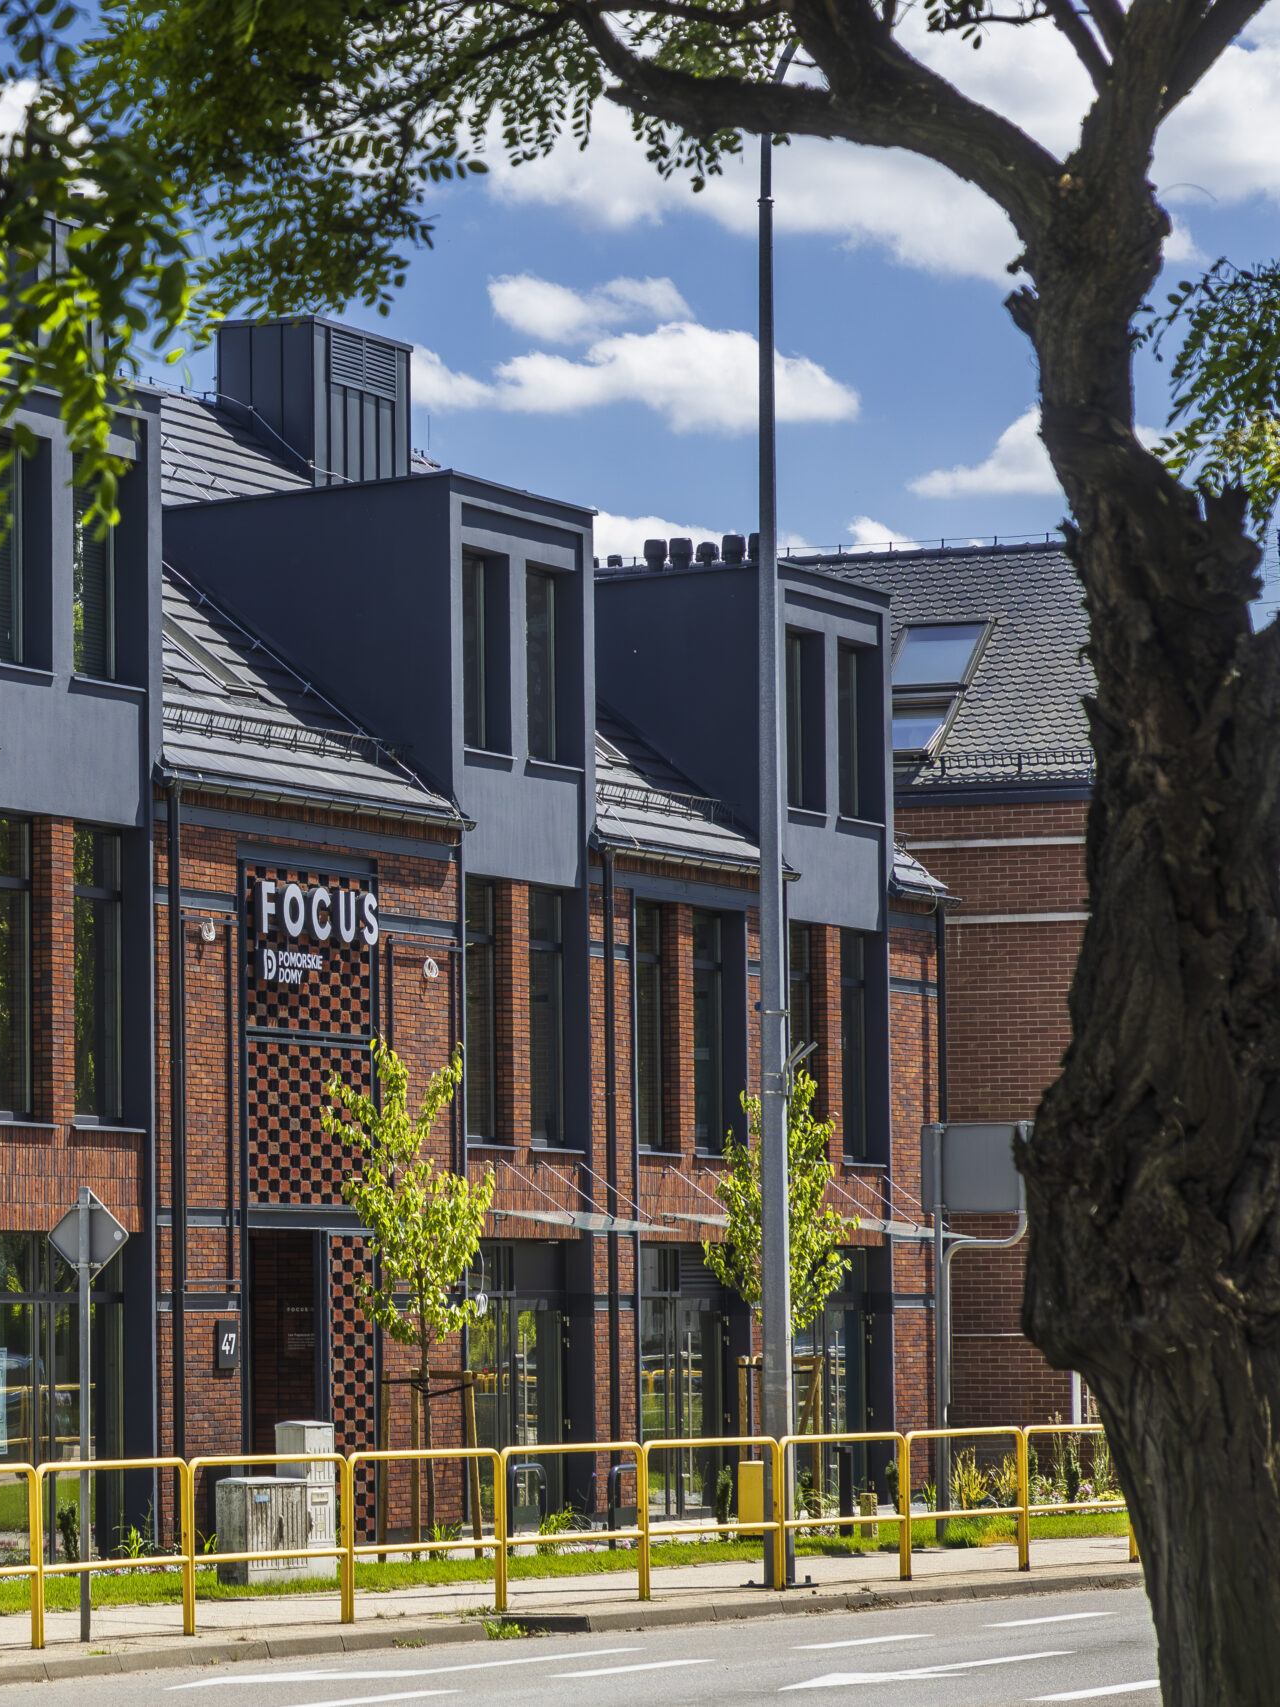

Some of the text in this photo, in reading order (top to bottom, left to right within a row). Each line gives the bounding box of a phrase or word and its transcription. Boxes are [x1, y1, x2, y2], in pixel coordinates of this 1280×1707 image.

[260, 880, 379, 946] FOCUS
[278, 950, 324, 970] POMORSKIE
[278, 967, 303, 985] DOMY
[221, 1332, 237, 1355] 47
